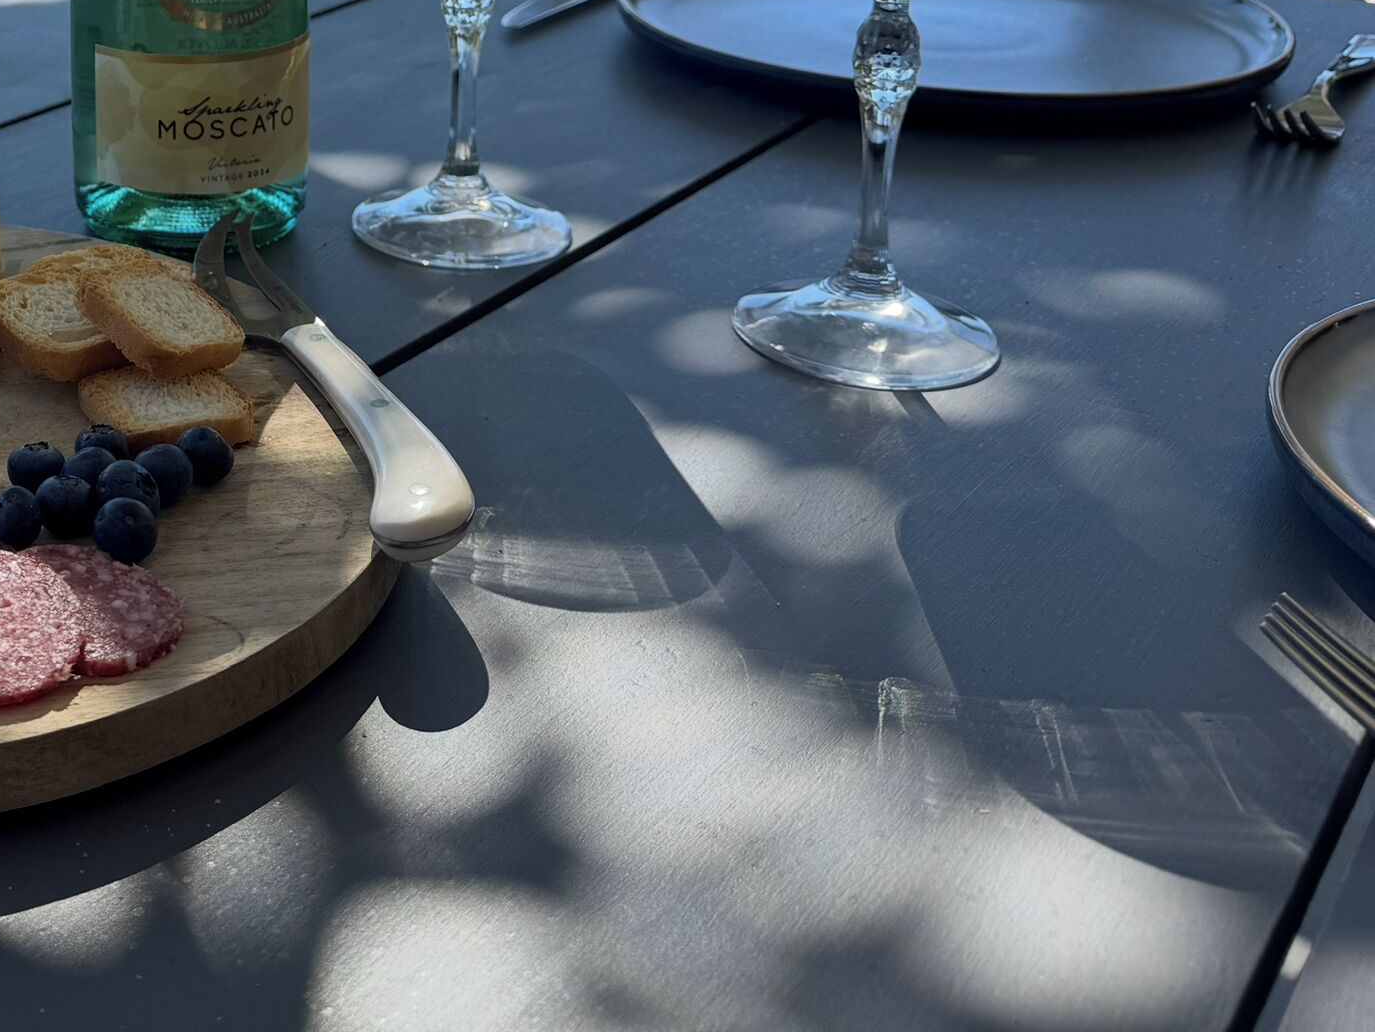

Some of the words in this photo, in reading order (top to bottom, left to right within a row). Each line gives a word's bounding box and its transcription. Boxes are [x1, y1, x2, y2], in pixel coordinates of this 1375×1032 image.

[226, 3, 272, 25] AUSTRALIA
[177, 93, 284, 121] Sparkling
[157, 105, 294, 141] MOSCATO
[199, 173, 244, 184] VINTAGE
[247, 167, 271, 179] 2024
